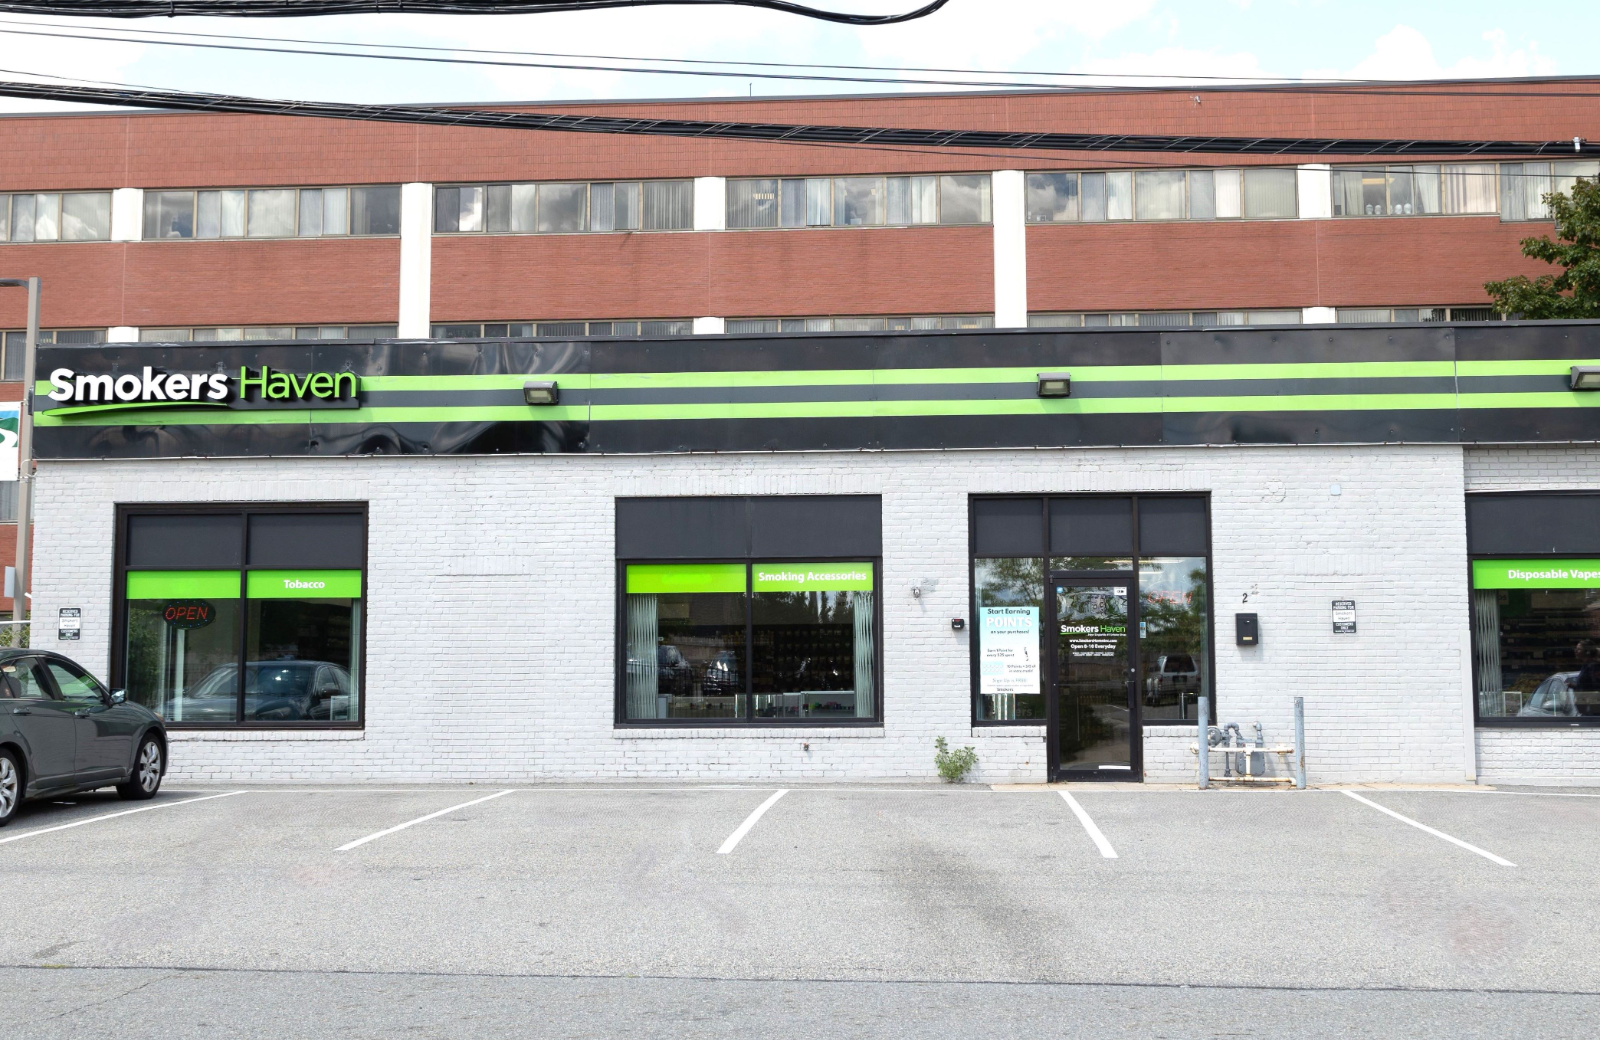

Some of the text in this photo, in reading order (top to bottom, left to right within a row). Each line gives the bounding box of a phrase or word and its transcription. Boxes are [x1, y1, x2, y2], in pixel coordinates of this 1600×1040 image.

[48, 365, 357, 401] Smokers Haven
[758, 571, 867, 583] Smoking Accessories
[1508, 569, 1568, 581] Disposable
[283, 579, 325, 589] Tobacco
[1147, 590, 1193, 604] OPEN
[1242, 592, 1249, 604] 2
[165, 606, 208, 620] OPEN
[986, 616, 1033, 628] POINTS
[1060, 624, 1126, 633] Smokers Haven
